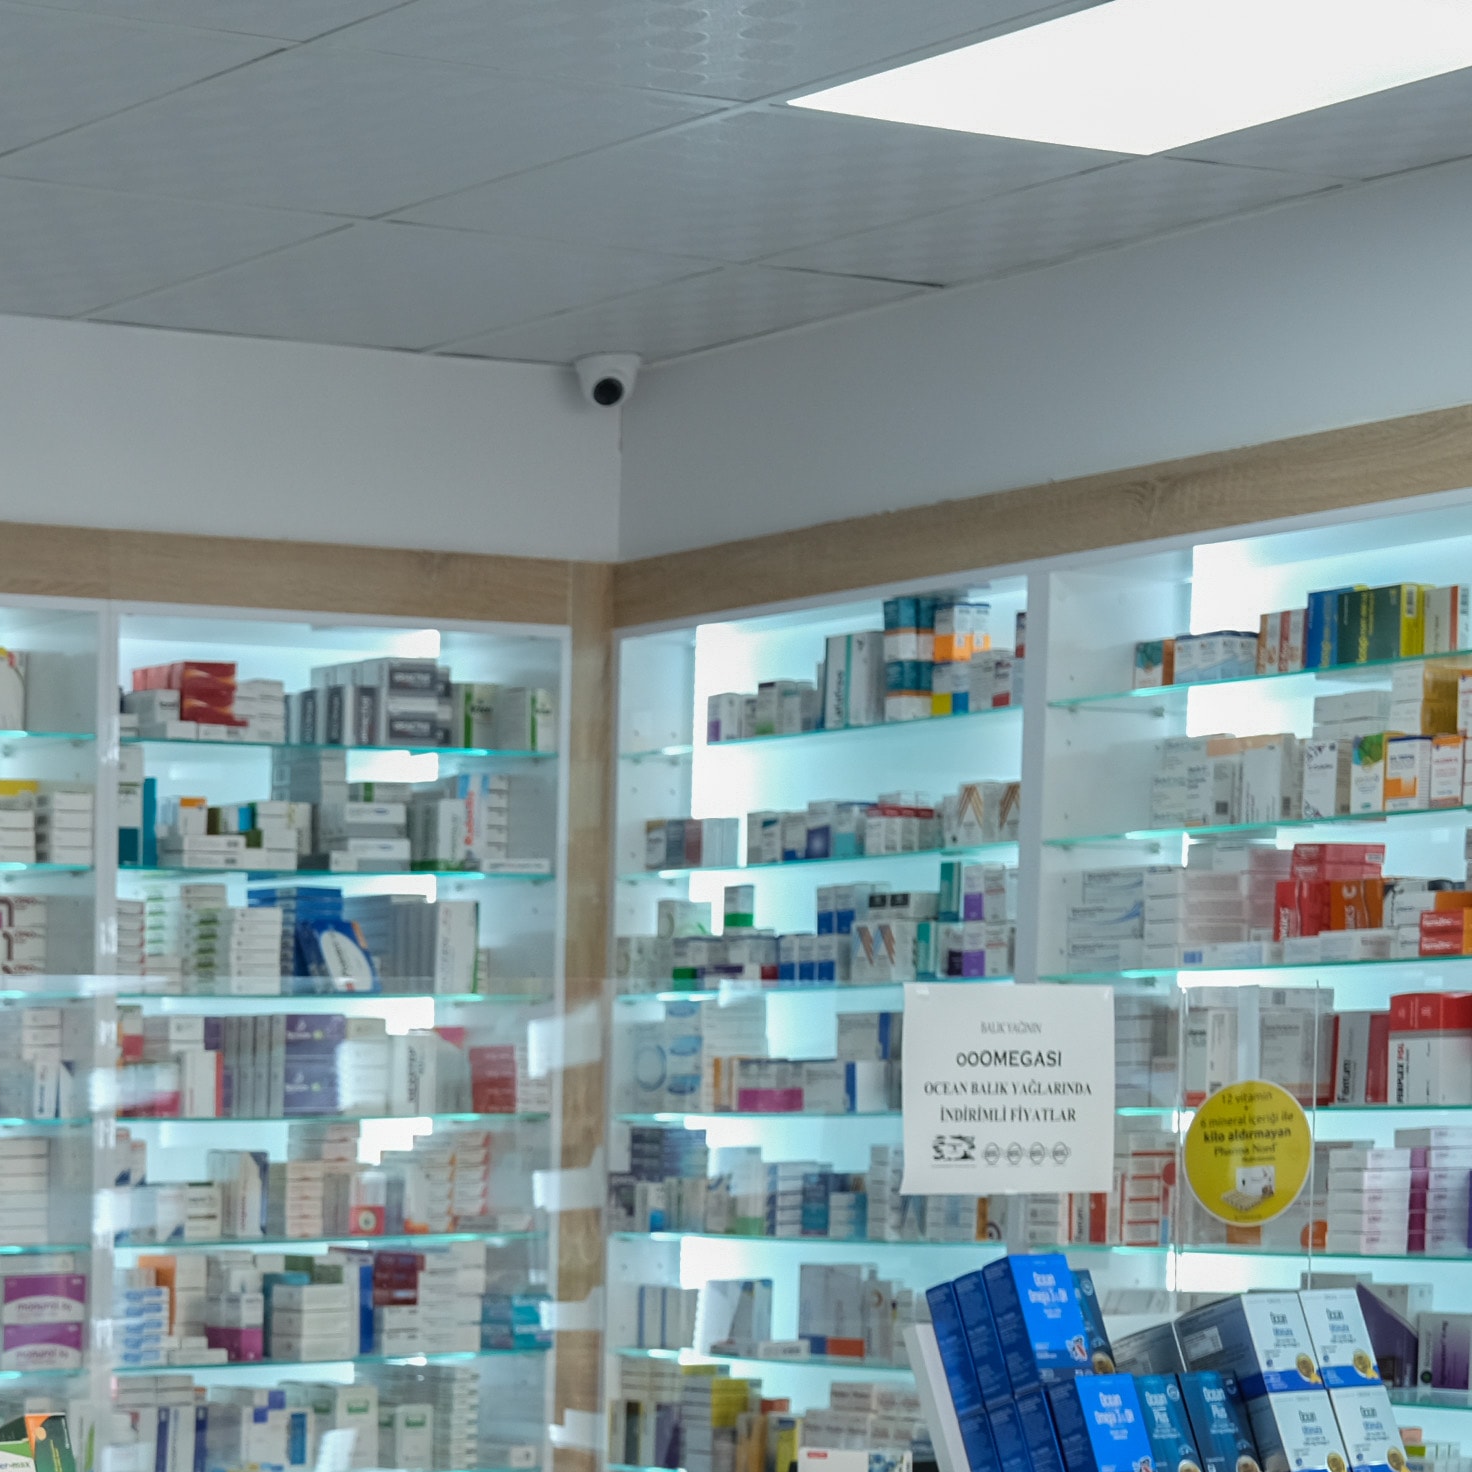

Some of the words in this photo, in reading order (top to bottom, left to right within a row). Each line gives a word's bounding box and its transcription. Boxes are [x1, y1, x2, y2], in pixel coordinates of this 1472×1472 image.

[924, 1080, 968, 1096] OCEAN
[971, 1080, 1008, 1096] BALIK
[1010, 1078, 1092, 1096] YAĞLARINDA
[940, 1105, 1007, 1123] İNDİRİMLİ
[1010, 1106, 1076, 1123] FİYATLAR
[1209, 1115, 1246, 1127] mineral
[1204, 1130, 1225, 1143] kilo
